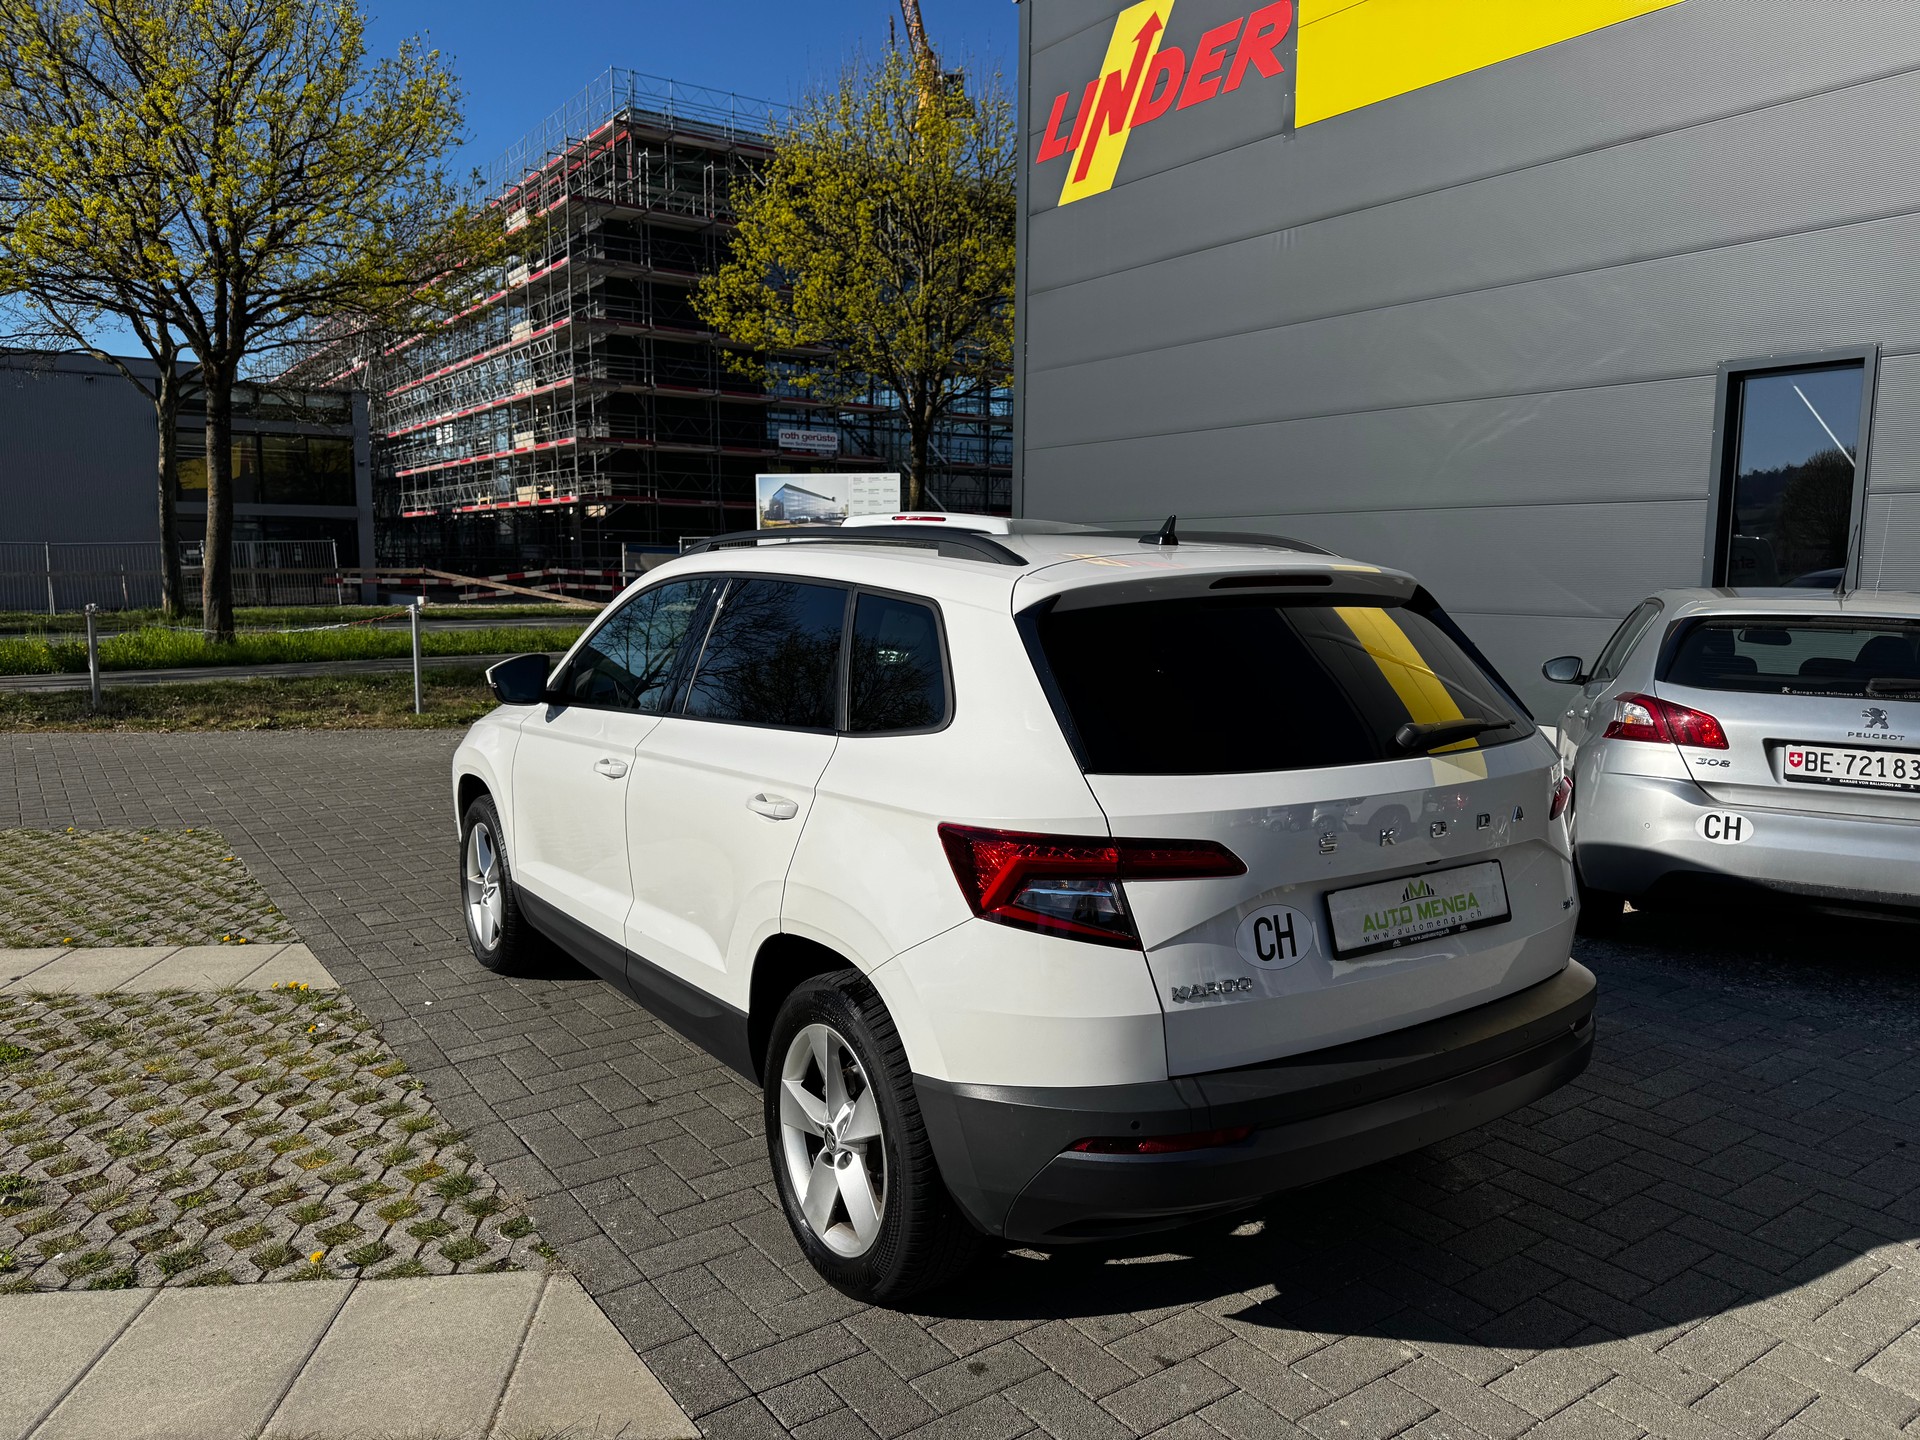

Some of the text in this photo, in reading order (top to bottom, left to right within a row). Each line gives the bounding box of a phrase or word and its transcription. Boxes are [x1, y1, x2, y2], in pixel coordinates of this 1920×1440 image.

[1036, 0, 1293, 184] LINDER
[780, 431, 837, 443] roth gerüste
[1847, 731, 1906, 741] PEUGEOT
[1695, 757, 1731, 768] 308
[1704, 814, 1742, 841] CH
[1362, 892, 1480, 933] AUTO MENGA
[1363, 908, 1483, 943] www.automenga.ch
[1253, 912, 1298, 962] CH
[1171, 976, 1253, 1001] KAROQ
